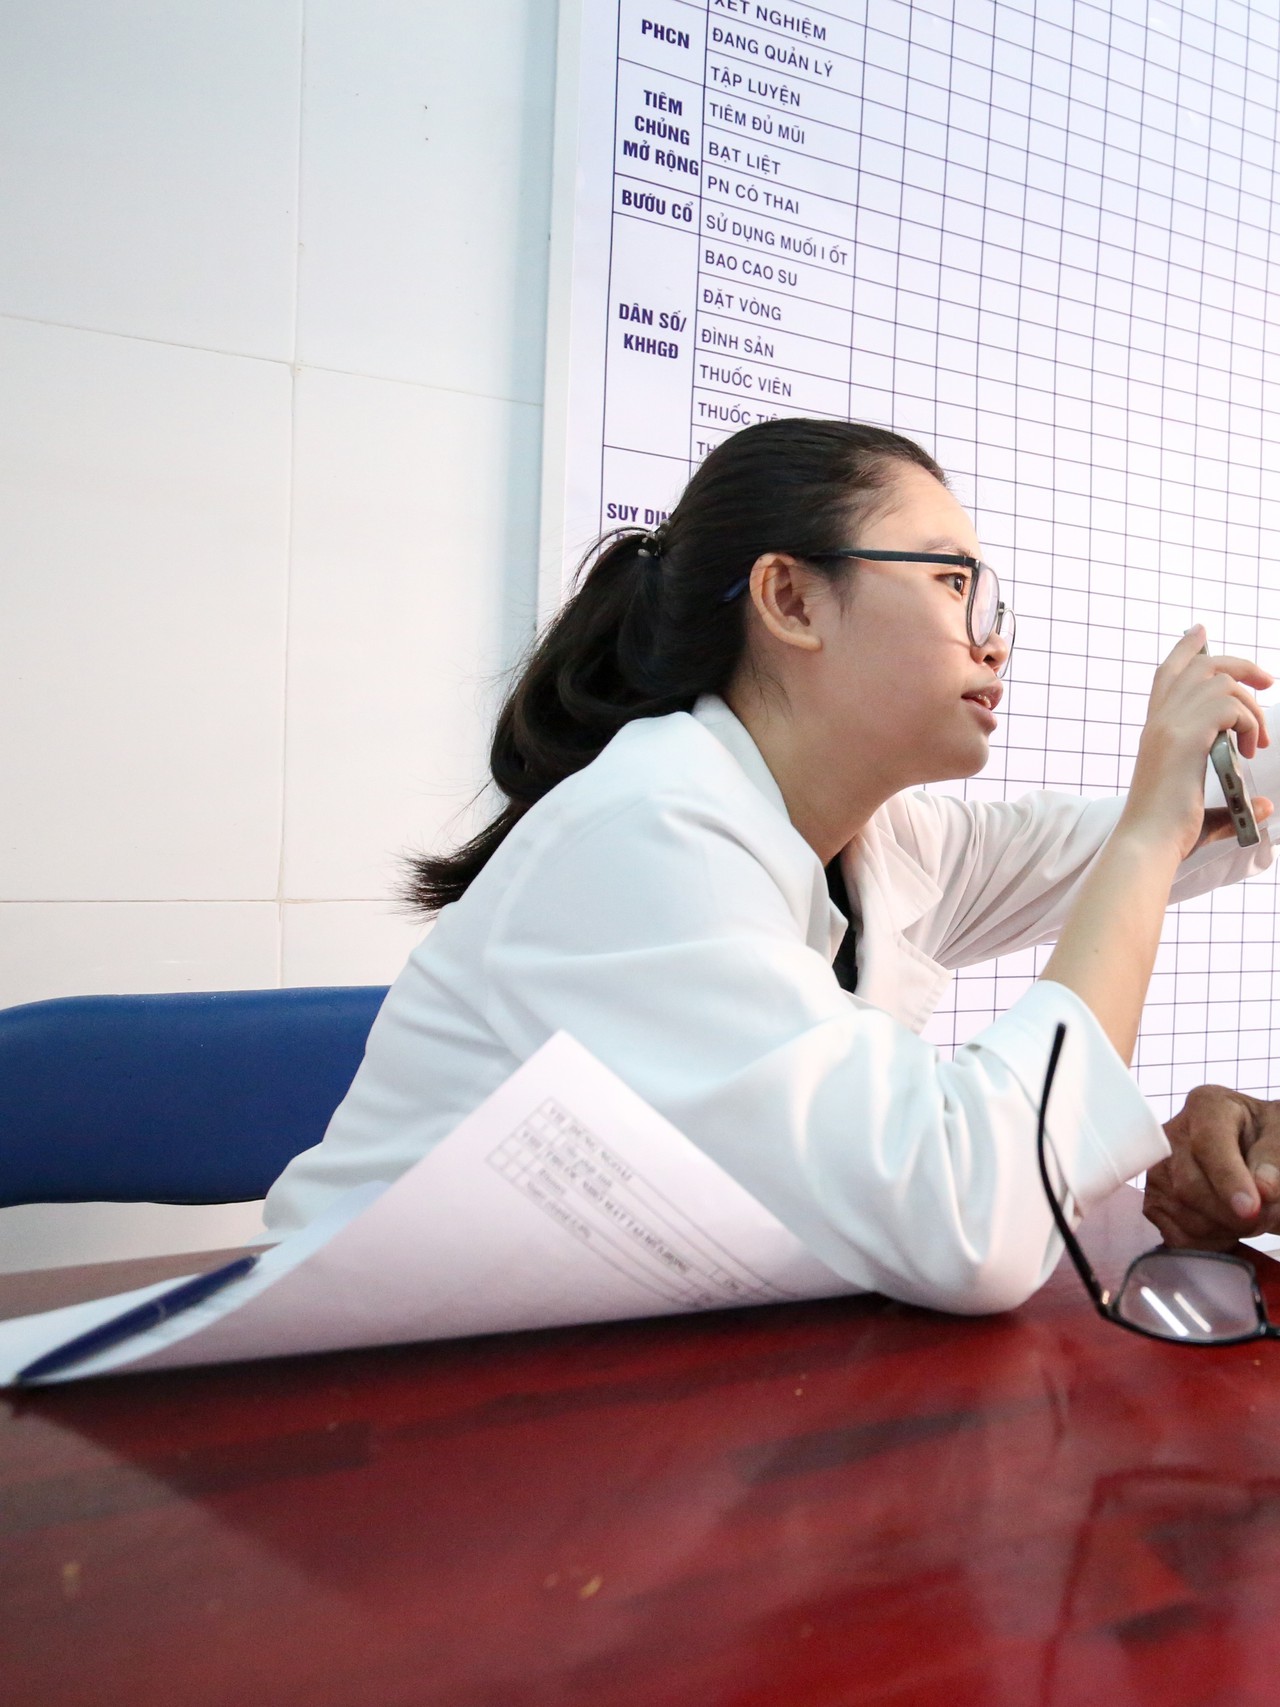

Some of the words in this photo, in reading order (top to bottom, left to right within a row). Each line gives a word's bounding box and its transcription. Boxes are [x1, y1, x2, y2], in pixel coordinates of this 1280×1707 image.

[641, 19, 690, 49] PHCN
[756, 5, 827, 41] NGHIỆM
[712, 27, 759, 55] ĐANG
[764, 44, 809, 71] QUẢN
[814, 58, 833, 78] LÝ
[643, 89, 683, 116] TIÊM
[710, 65, 742, 88] TẬP
[748, 78, 801, 107] LUYỆN
[634, 115, 690, 146] CHỦNG
[709, 102, 746, 127] TIÊM
[752, 113, 773, 135] ĐỦ
[778, 121, 805, 144] MŨI
[623, 139, 651, 162] MỞ
[655, 148, 699, 176] RỘNG
[708, 141, 741, 163] BẠT
[746, 151, 781, 176] LIỆT
[622, 189, 666, 215] BƯỚU
[671, 201, 694, 223] CỔ
[707, 176, 730, 194] PN
[735, 182, 759, 202] CÓ
[763, 192, 800, 215] THAI
[705, 212, 728, 232] SỬ
[732, 222, 775, 246] DỤNG
[780, 233, 817, 258] MUỐI
[829, 243, 848, 266] ỐT
[705, 250, 738, 271] BAO
[742, 260, 774, 280] CAO
[778, 269, 798, 287] SU
[618, 302, 653, 326] DÂN
[658, 310, 687, 333] SỐ/
[703, 288, 734, 310] ĐẶT
[739, 296, 782, 321] VÒNG
[623, 333, 679, 359] KHHGĐ
[701, 328, 739, 350] ĐÌNH
[744, 336, 774, 358] SẢN
[699, 364, 753, 388] THUỐC
[758, 376, 792, 397] VIÊN
[697, 402, 751, 426] THUỐC
[606, 503, 639, 522] SUY
